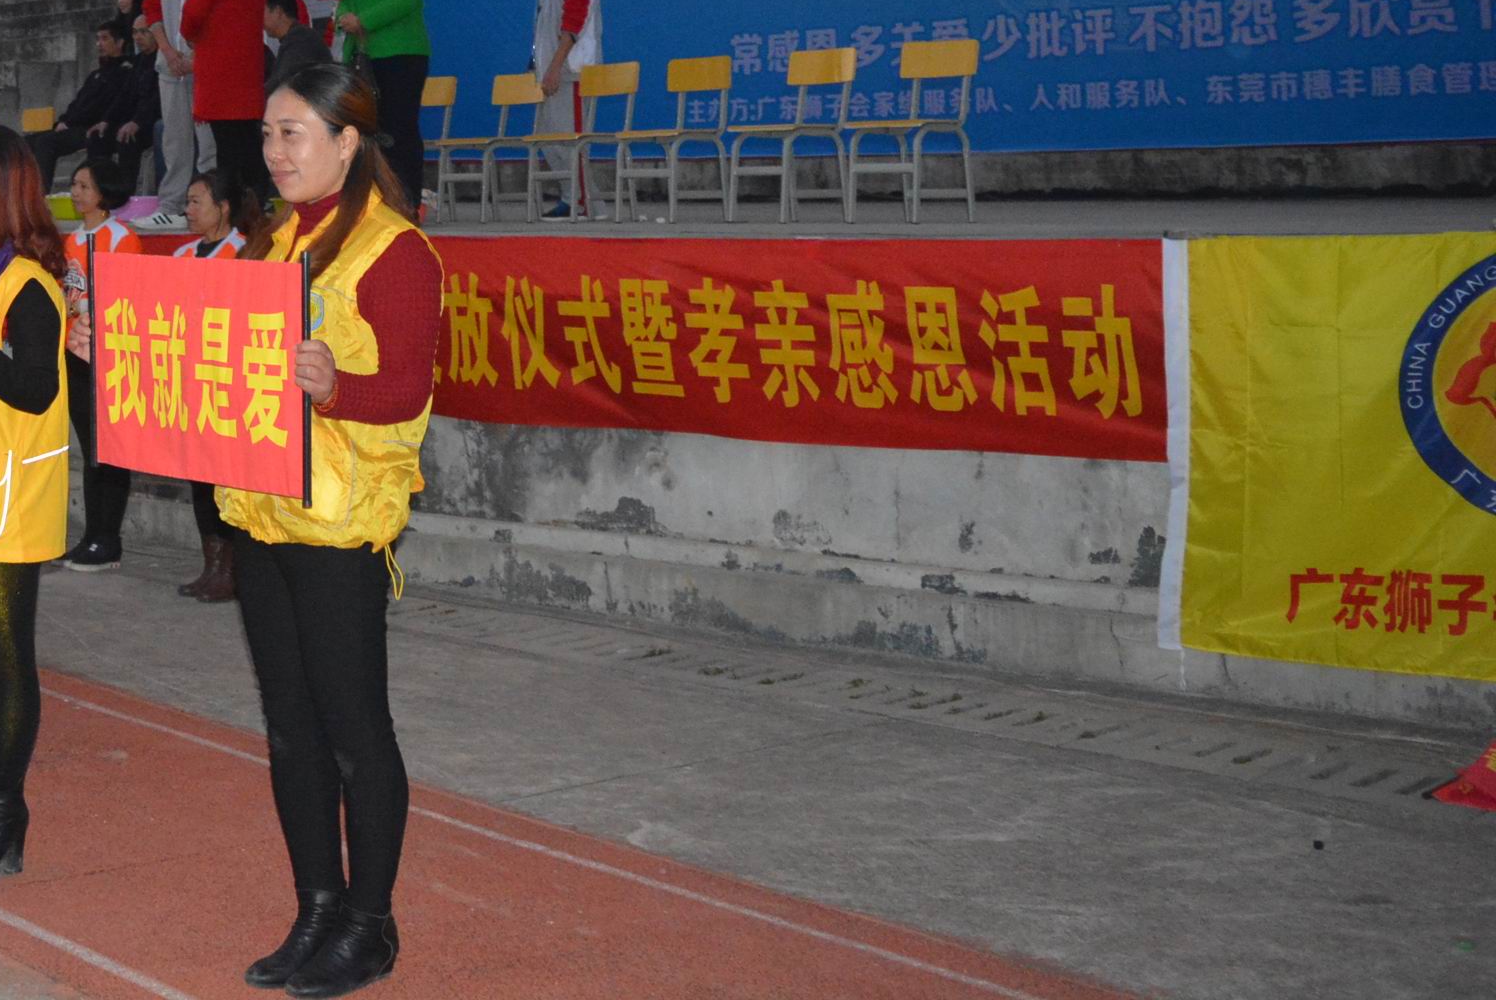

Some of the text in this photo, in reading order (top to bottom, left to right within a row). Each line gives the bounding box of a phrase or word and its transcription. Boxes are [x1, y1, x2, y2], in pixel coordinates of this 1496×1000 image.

[983, 7, 1116, 62] 少批评
[103, 297, 289, 449] 我就是爱
[434, 270, 1145, 418] 放仪式暨孝亲感恩活动
[1406, 341, 1432, 409] CHINA
[1285, 566, 1496, 637] 广东狮子
